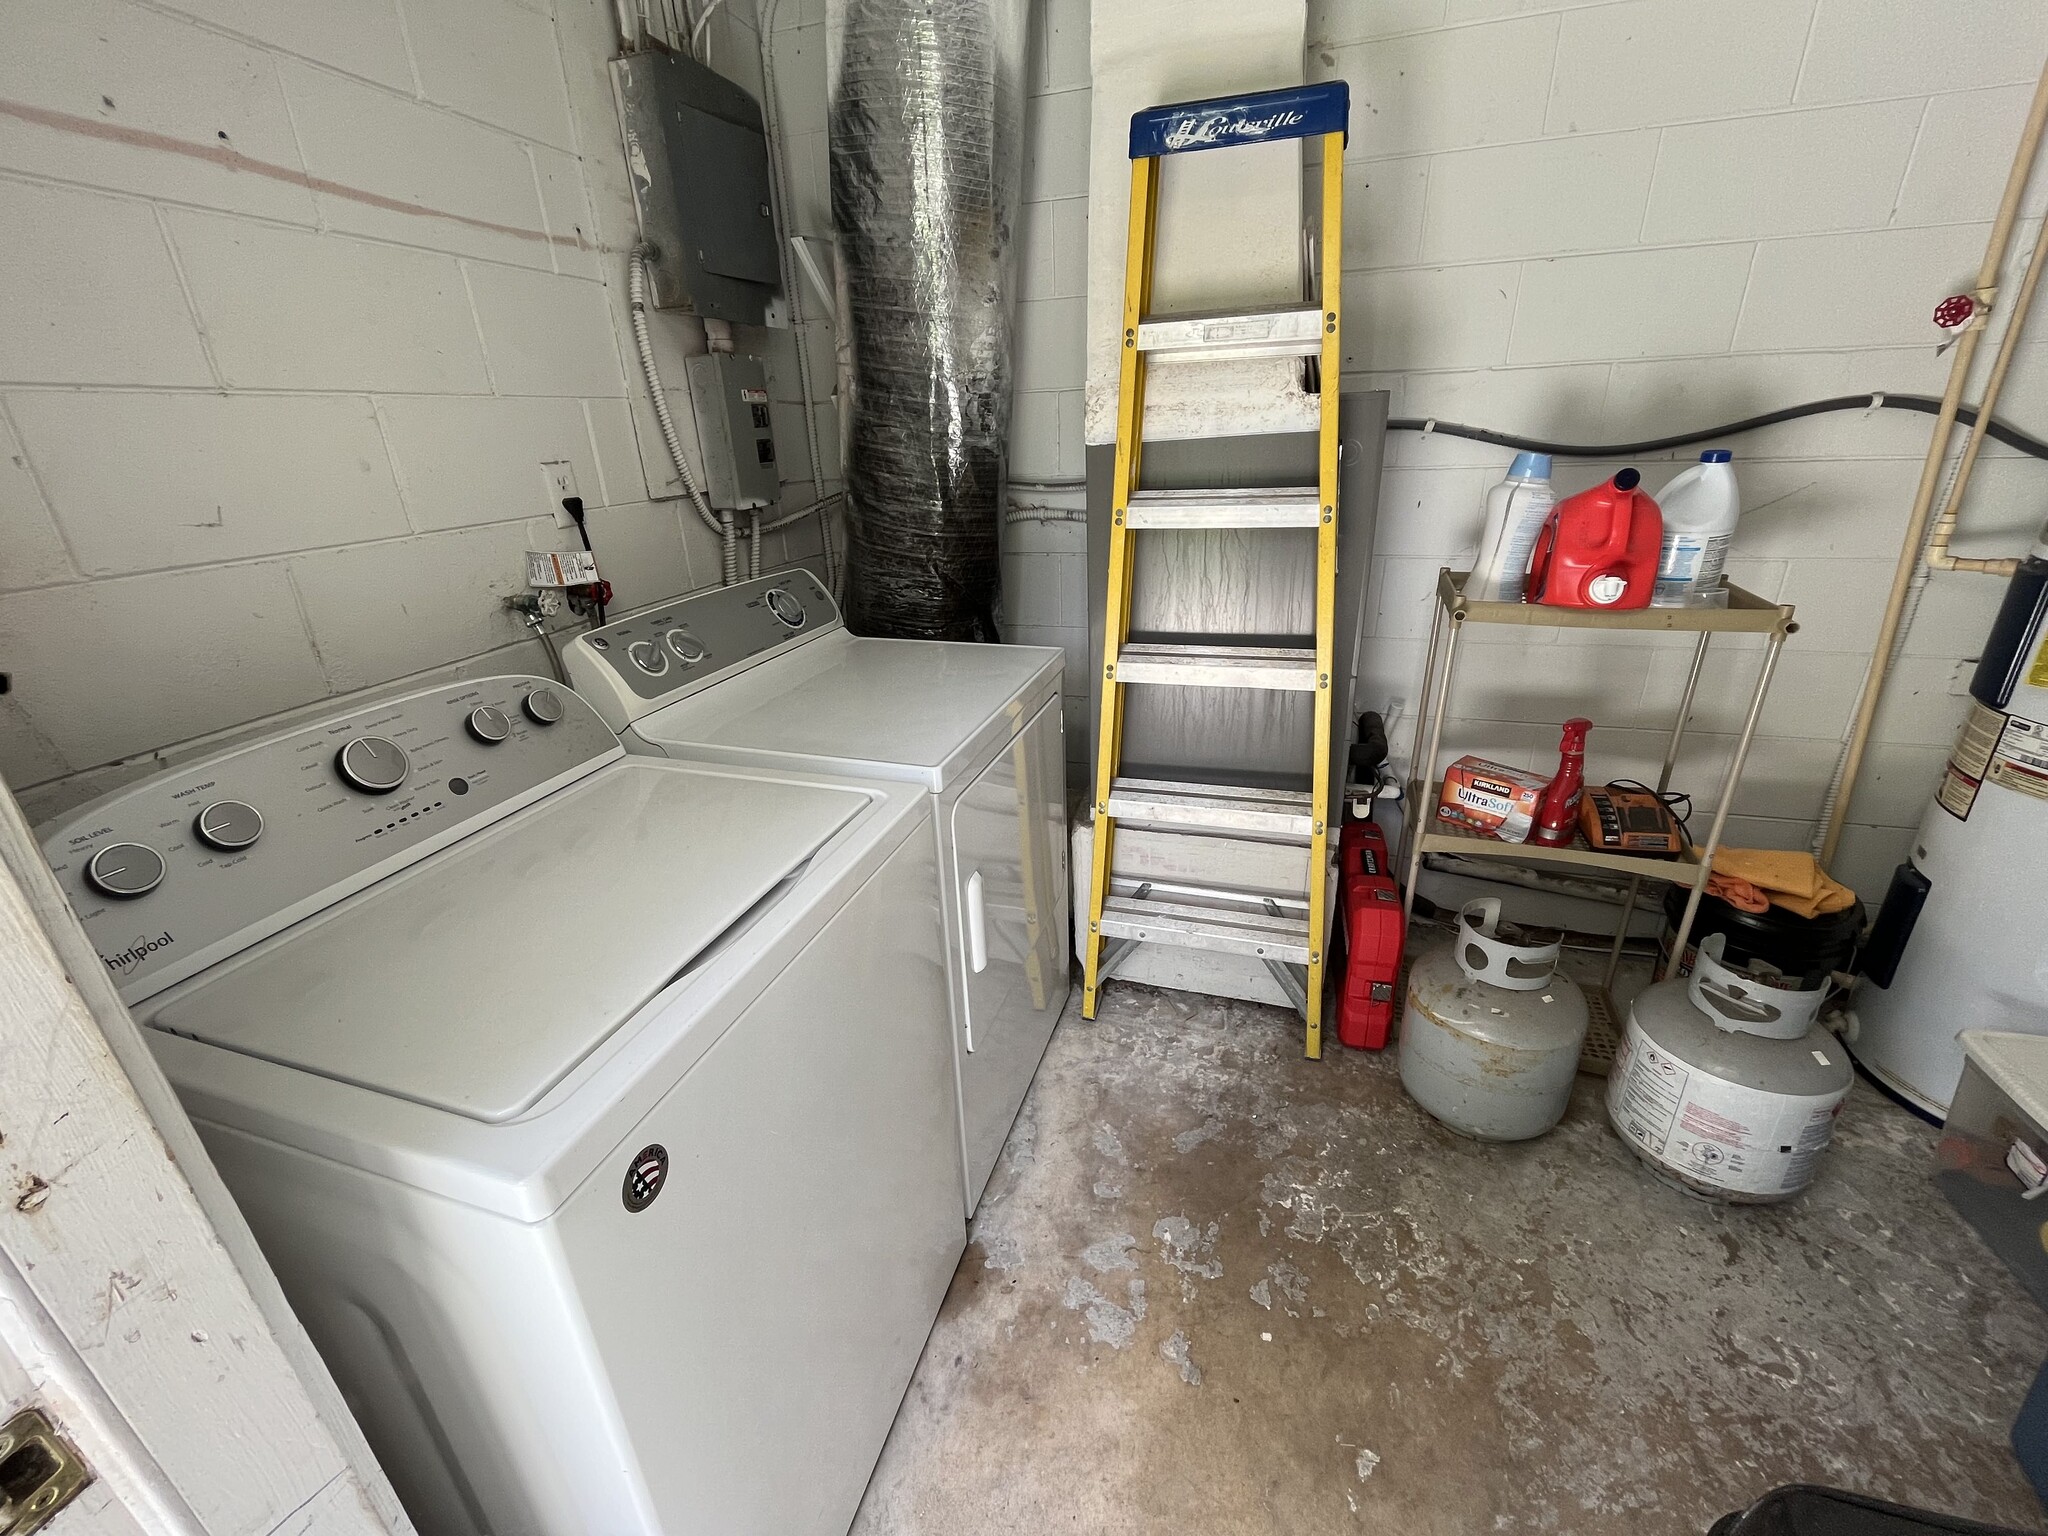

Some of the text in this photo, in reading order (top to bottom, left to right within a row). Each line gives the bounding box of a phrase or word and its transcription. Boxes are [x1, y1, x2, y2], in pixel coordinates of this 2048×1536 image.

[328, 724, 352, 735] Normal
[171, 781, 216, 799] WASH TEMP
[1473, 779, 1511, 794] KIRKLAND
[68, 827, 114, 846] SOIL LEVEL
[101, 931, 175, 973] hirlpool
[629, 1147, 667, 1179] AMERICA
